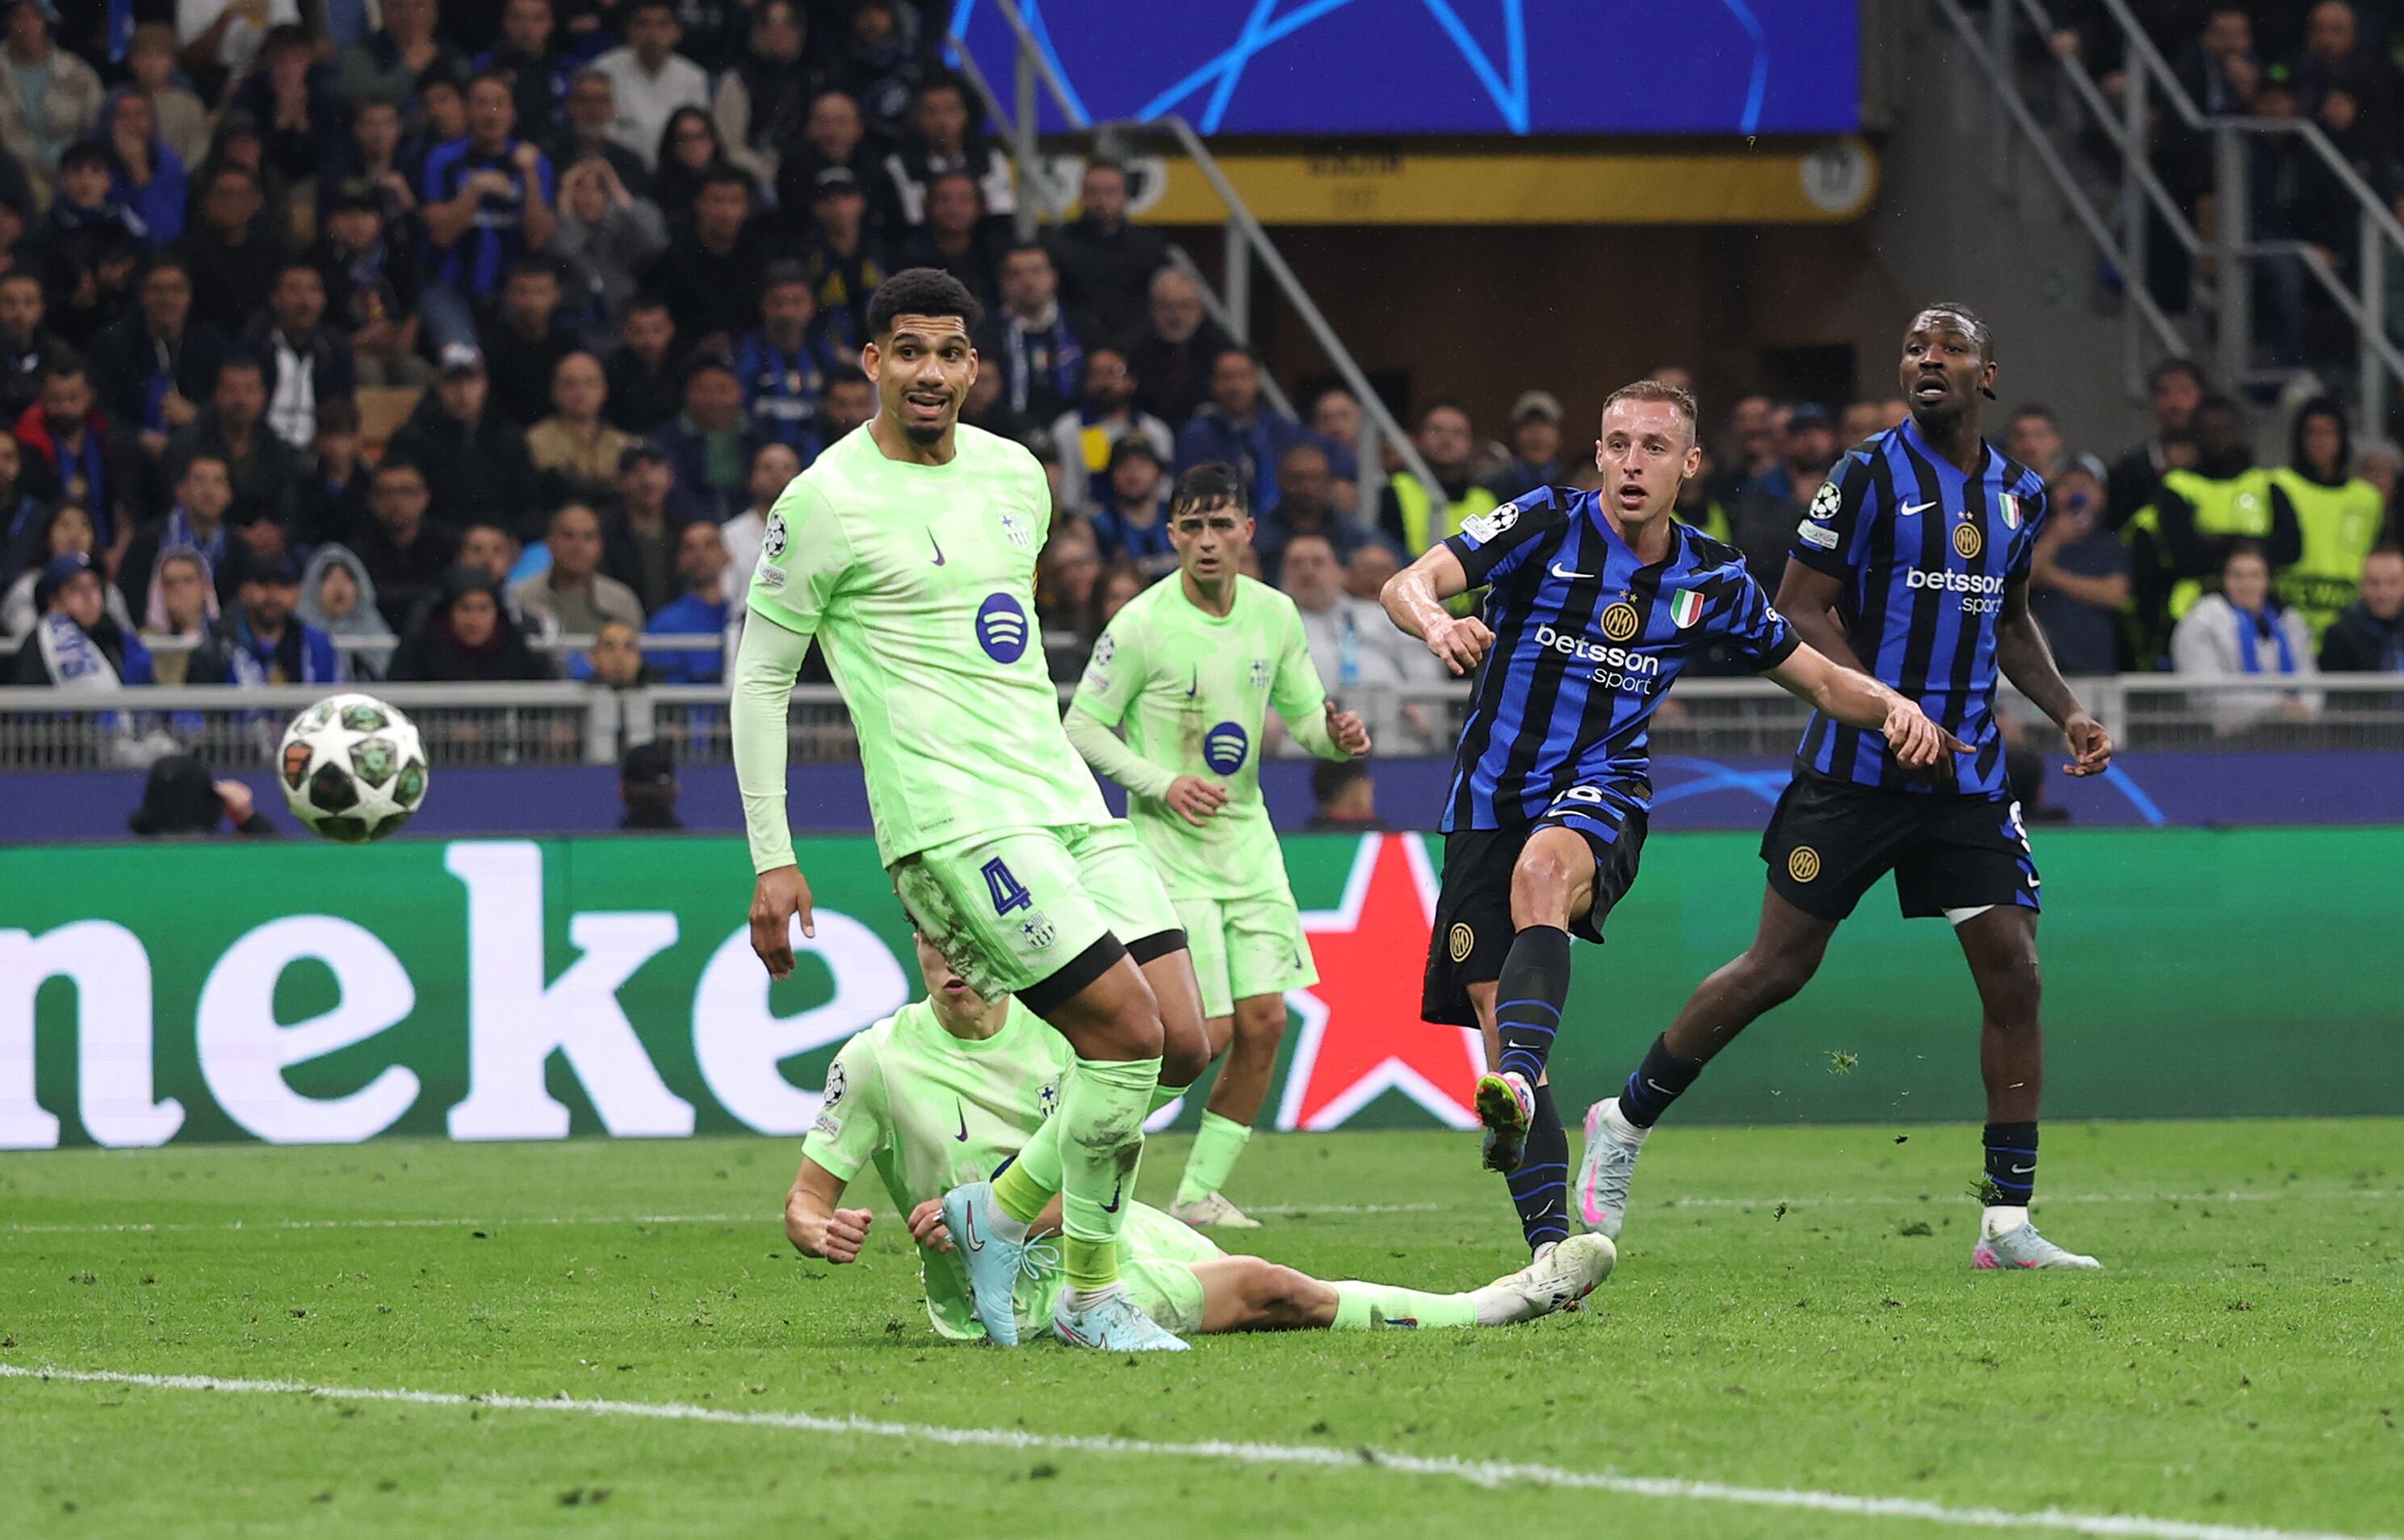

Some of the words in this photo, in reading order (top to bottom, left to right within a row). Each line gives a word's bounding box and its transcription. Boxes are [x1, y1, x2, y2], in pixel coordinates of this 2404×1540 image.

[1534, 622, 1659, 676] betsson
[1585, 667, 1652, 695] .sport
[979, 856, 1033, 917] 4
[0, 840, 1183, 1149] neke
